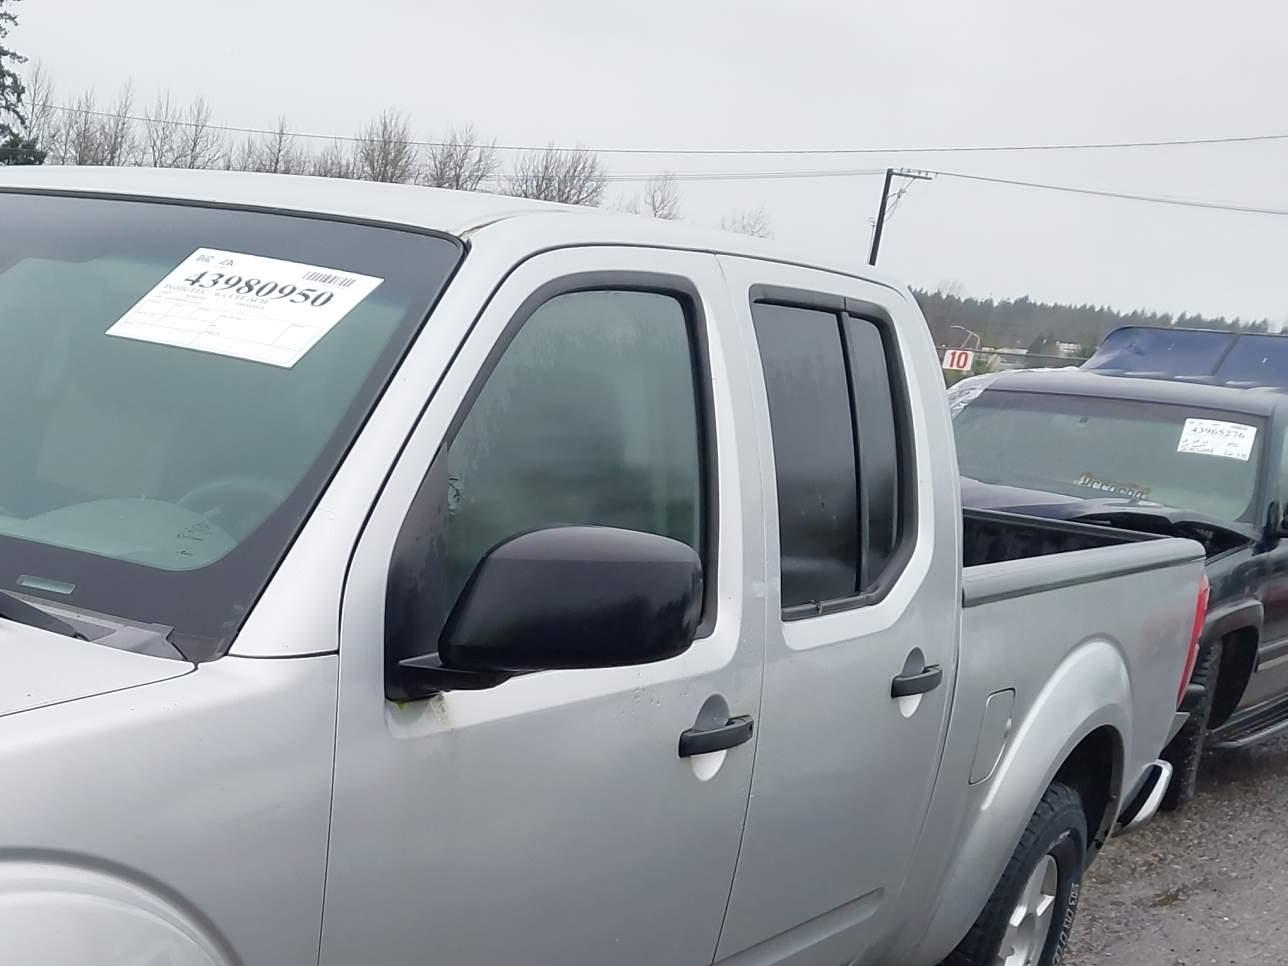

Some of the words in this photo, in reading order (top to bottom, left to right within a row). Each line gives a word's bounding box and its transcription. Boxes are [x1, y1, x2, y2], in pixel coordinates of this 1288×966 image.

[184, 270, 335, 308] 43980950
[949, 351, 969, 369] 10
[1192, 426, 1246, 439] 43965276
